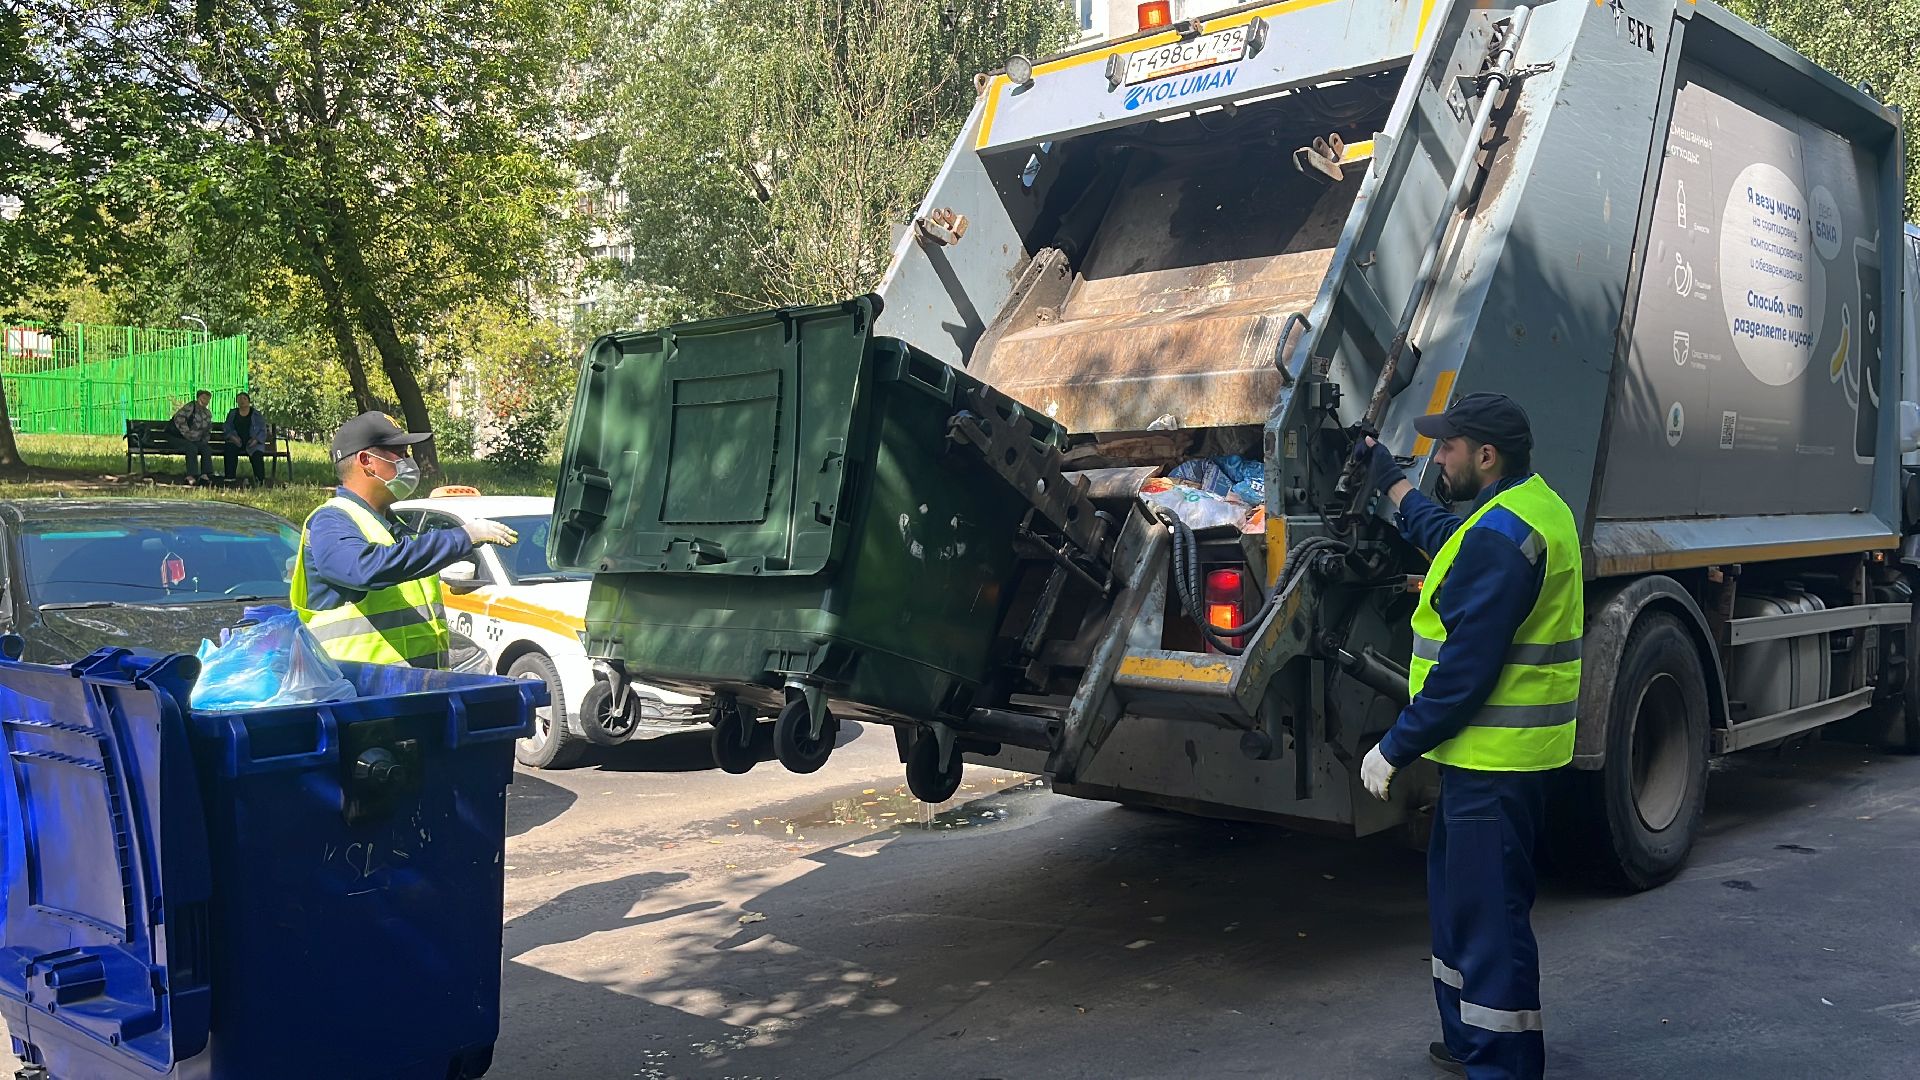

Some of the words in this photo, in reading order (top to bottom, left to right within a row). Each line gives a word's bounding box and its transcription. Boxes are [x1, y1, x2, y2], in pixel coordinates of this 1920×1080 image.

[1212, 30, 1242, 50] 799
[1141, 66, 1239, 105] KOLUMAN
[1747, 186, 1754, 204] Я
[1755, 192, 1775, 215] везу
[1776, 200, 1801, 225] мусор
[1752, 216, 1761, 227] на
[1815, 220, 1837, 244] БАКА
[1750, 236, 1803, 262] компостирование
[1750, 258, 1754, 268] и
[1755, 258, 1803, 282] обезвреживание
[1747, 289, 1785, 318] Спасибо,
[1787, 303, 1804, 319] что
[1733, 317, 1787, 341] разделяете
[1788, 329, 1814, 351] мусор!
[458, 616, 472, 636] Go
